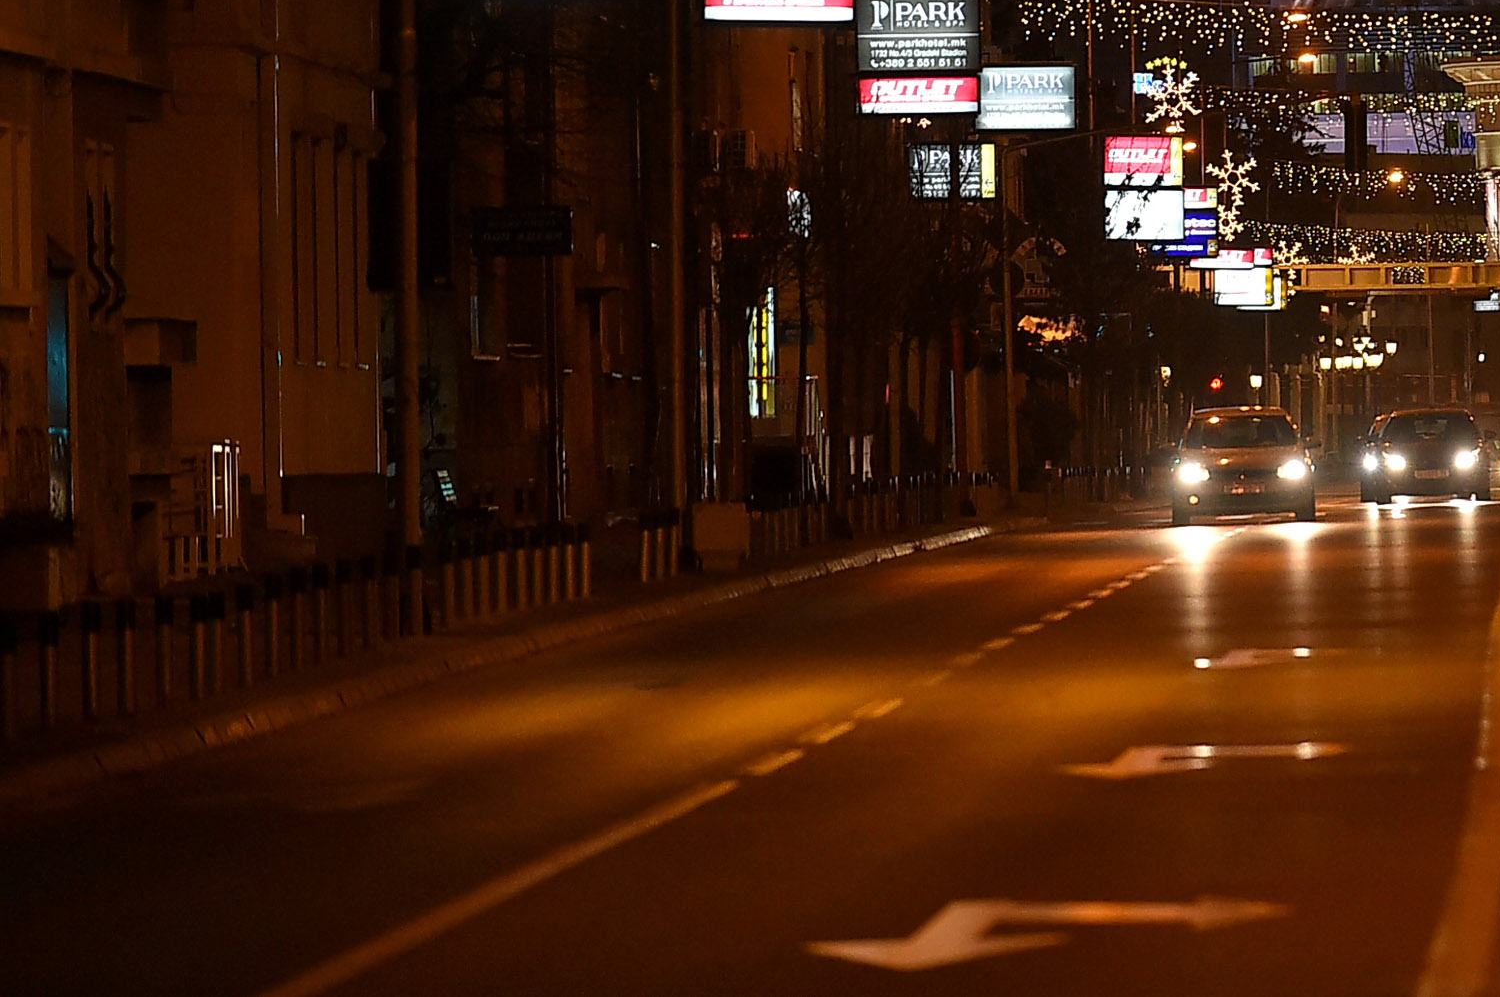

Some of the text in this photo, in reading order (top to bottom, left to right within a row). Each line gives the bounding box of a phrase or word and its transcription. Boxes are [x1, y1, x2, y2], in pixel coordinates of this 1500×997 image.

[896, 1, 966, 21] PARK
[896, 20, 929, 28] HOTEL
[870, 39, 967, 49] www.parkhotel.mk
[1007, 73, 1064, 89] PARK
